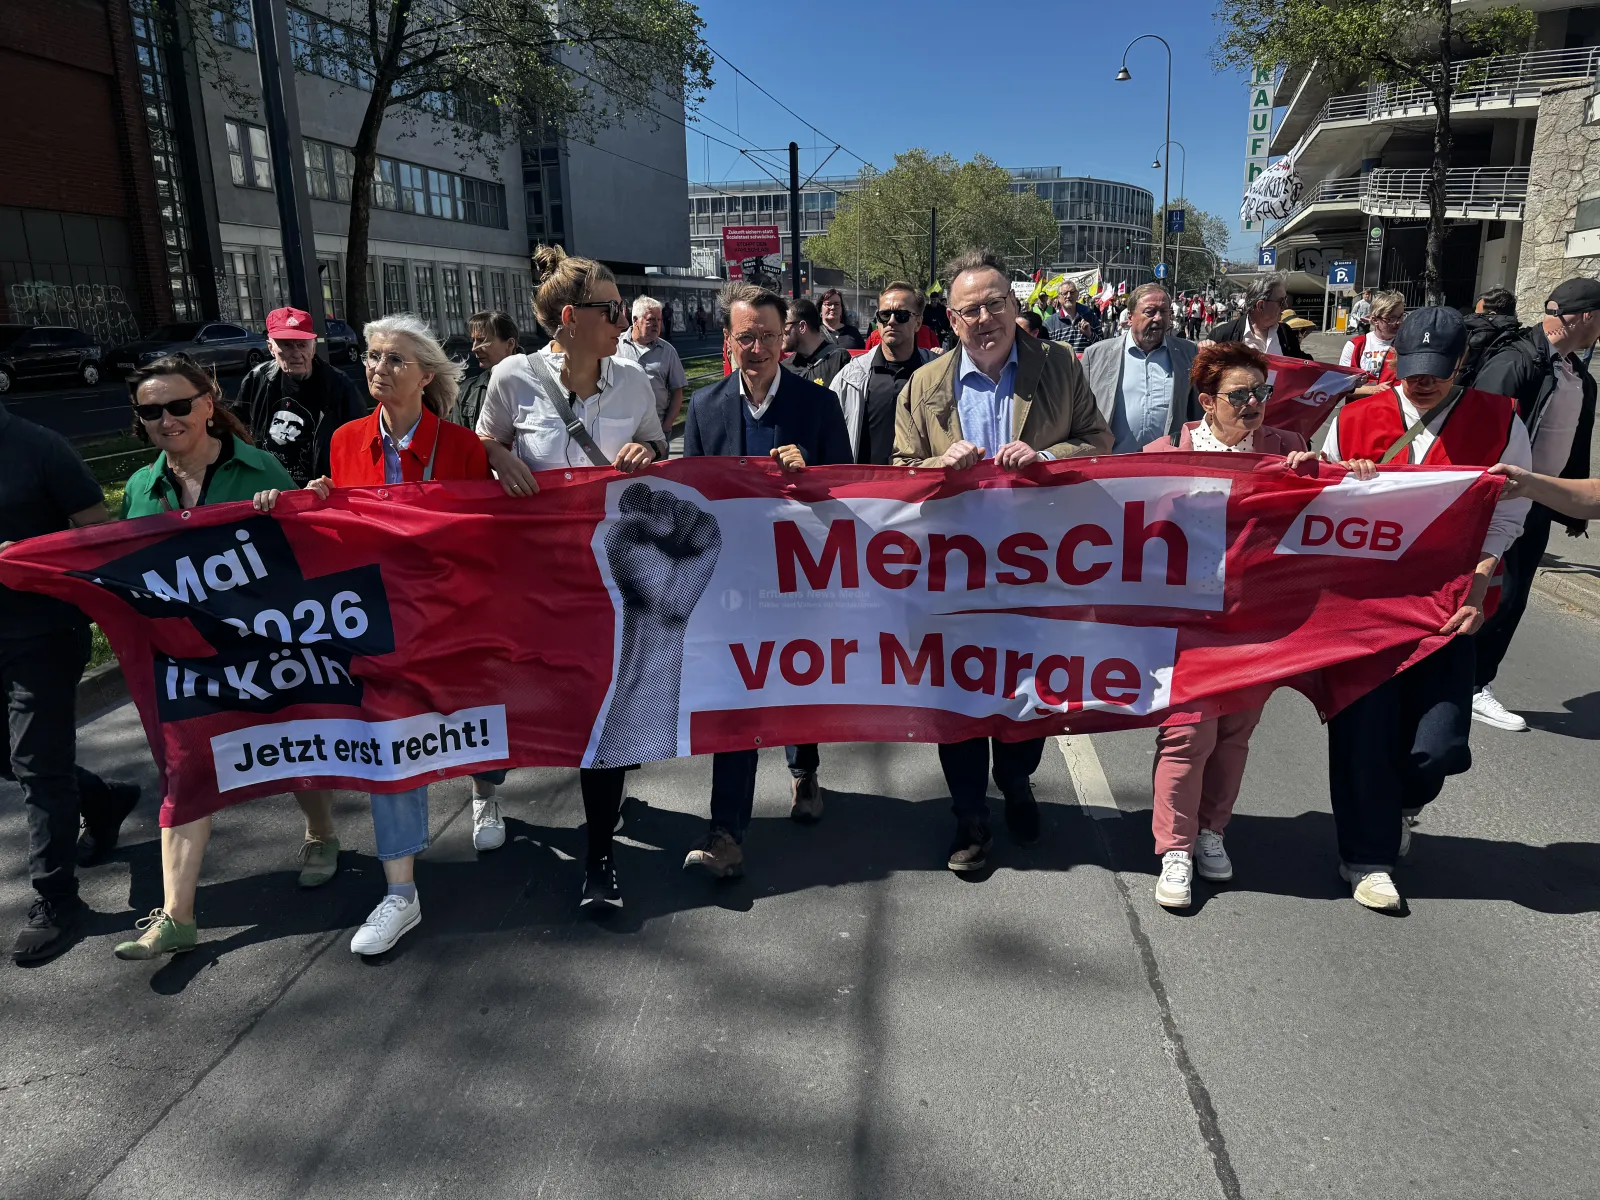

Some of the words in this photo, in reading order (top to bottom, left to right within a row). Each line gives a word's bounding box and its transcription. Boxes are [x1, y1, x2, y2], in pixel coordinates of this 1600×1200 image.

[139, 529, 268, 603] Mai
[772, 500, 1189, 593] Mensch
[1301, 514, 1404, 552] DGB
[728, 636, 859, 691] vor
[879, 630, 1142, 717] Marge
[234, 734, 328, 772] Jetzt
[334, 737, 384, 766] erst
[391, 718, 490, 765] recht!
